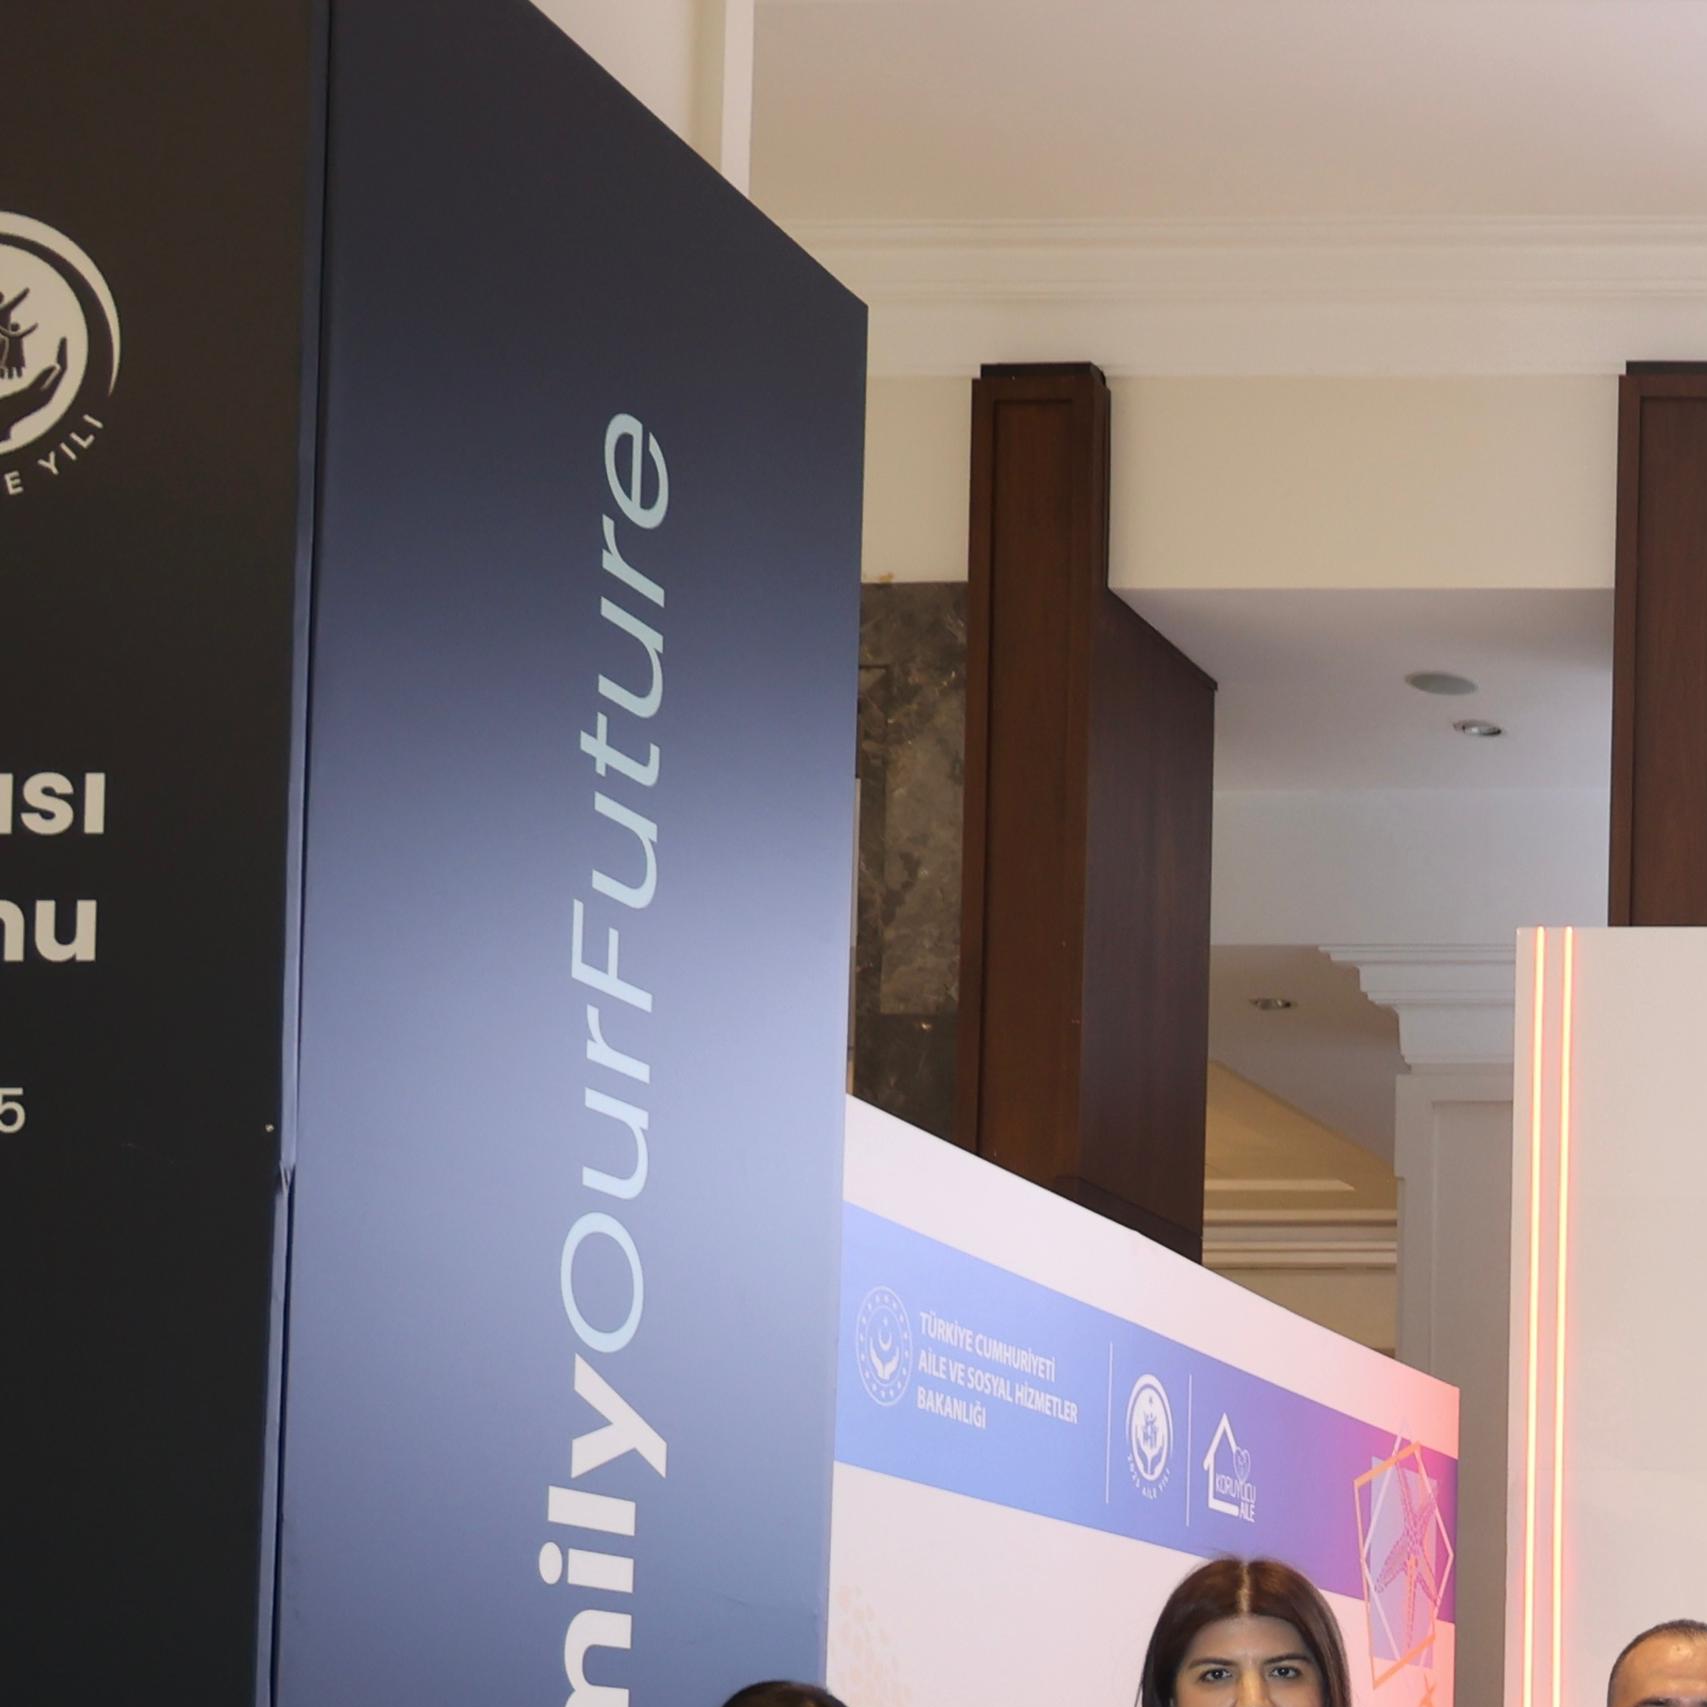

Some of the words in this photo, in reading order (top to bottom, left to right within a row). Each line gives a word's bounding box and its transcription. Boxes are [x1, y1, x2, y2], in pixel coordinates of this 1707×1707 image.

[37, 413, 104, 476] YILI
[920, 1310, 974, 1352] TÜRKİYE
[975, 1333, 1056, 1382] CUMHURİYETİ
[917, 1386, 986, 1429] BAKANLIĞI
[919, 1347, 947, 1380] AİLE
[948, 1359, 966, 1386] VE
[967, 1367, 1013, 1403] SOSYAL
[1014, 1381, 1079, 1424] HİZMETLER
